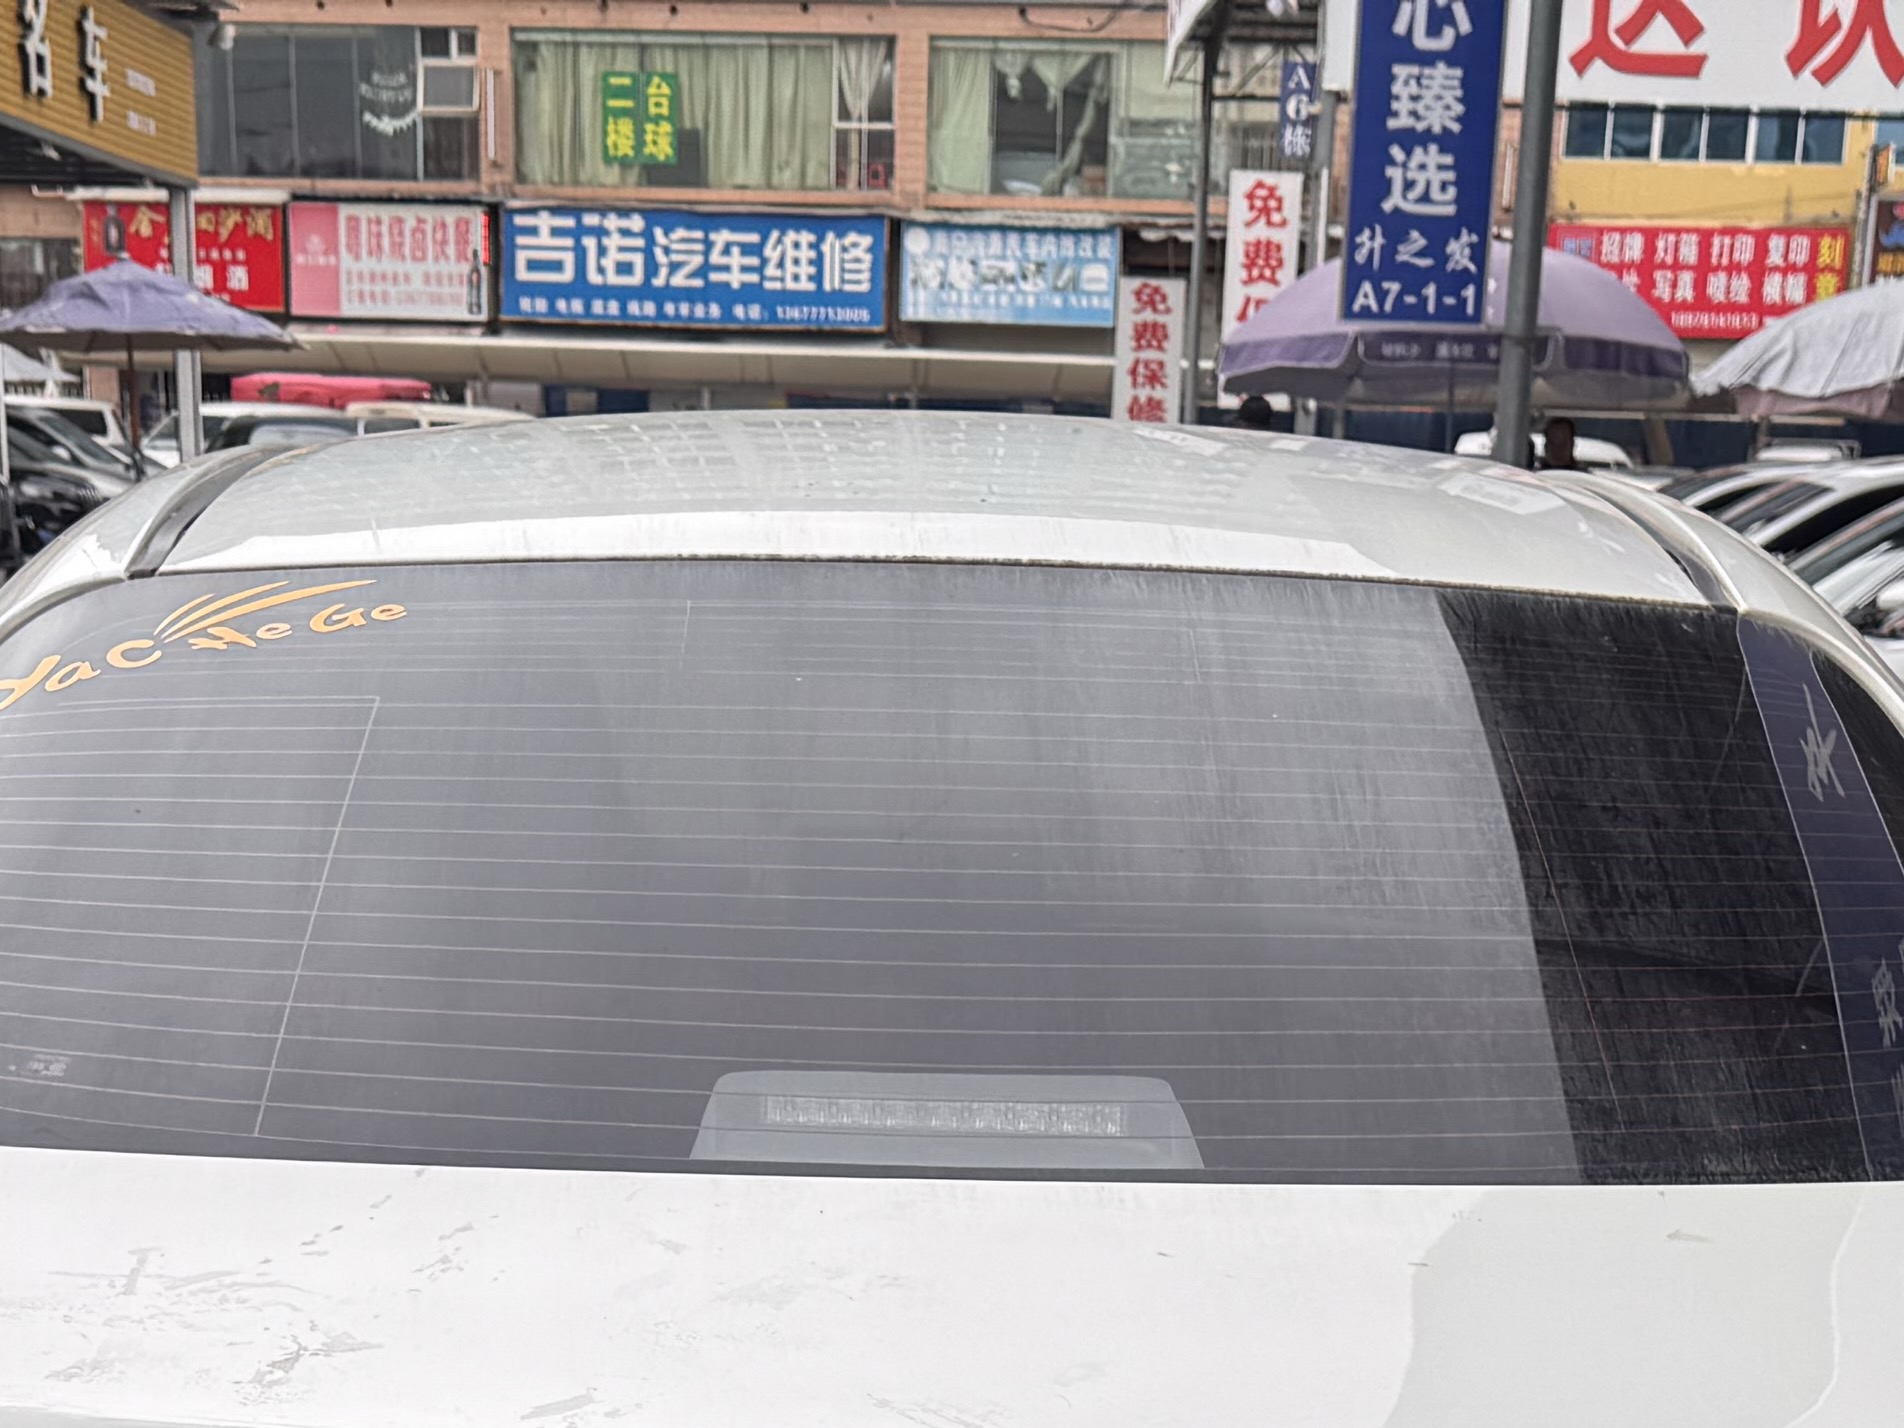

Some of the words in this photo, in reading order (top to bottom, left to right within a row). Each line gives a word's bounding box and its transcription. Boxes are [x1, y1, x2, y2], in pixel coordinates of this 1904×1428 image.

[605, 76, 635, 158] 二楼
[643, 75, 674, 161] 台球
[512, 210, 875, 293] 吉诺汽车维修
[1352, 279, 1476, 317] A7-1-1
[1127, 281, 1173, 423] 免费保修
